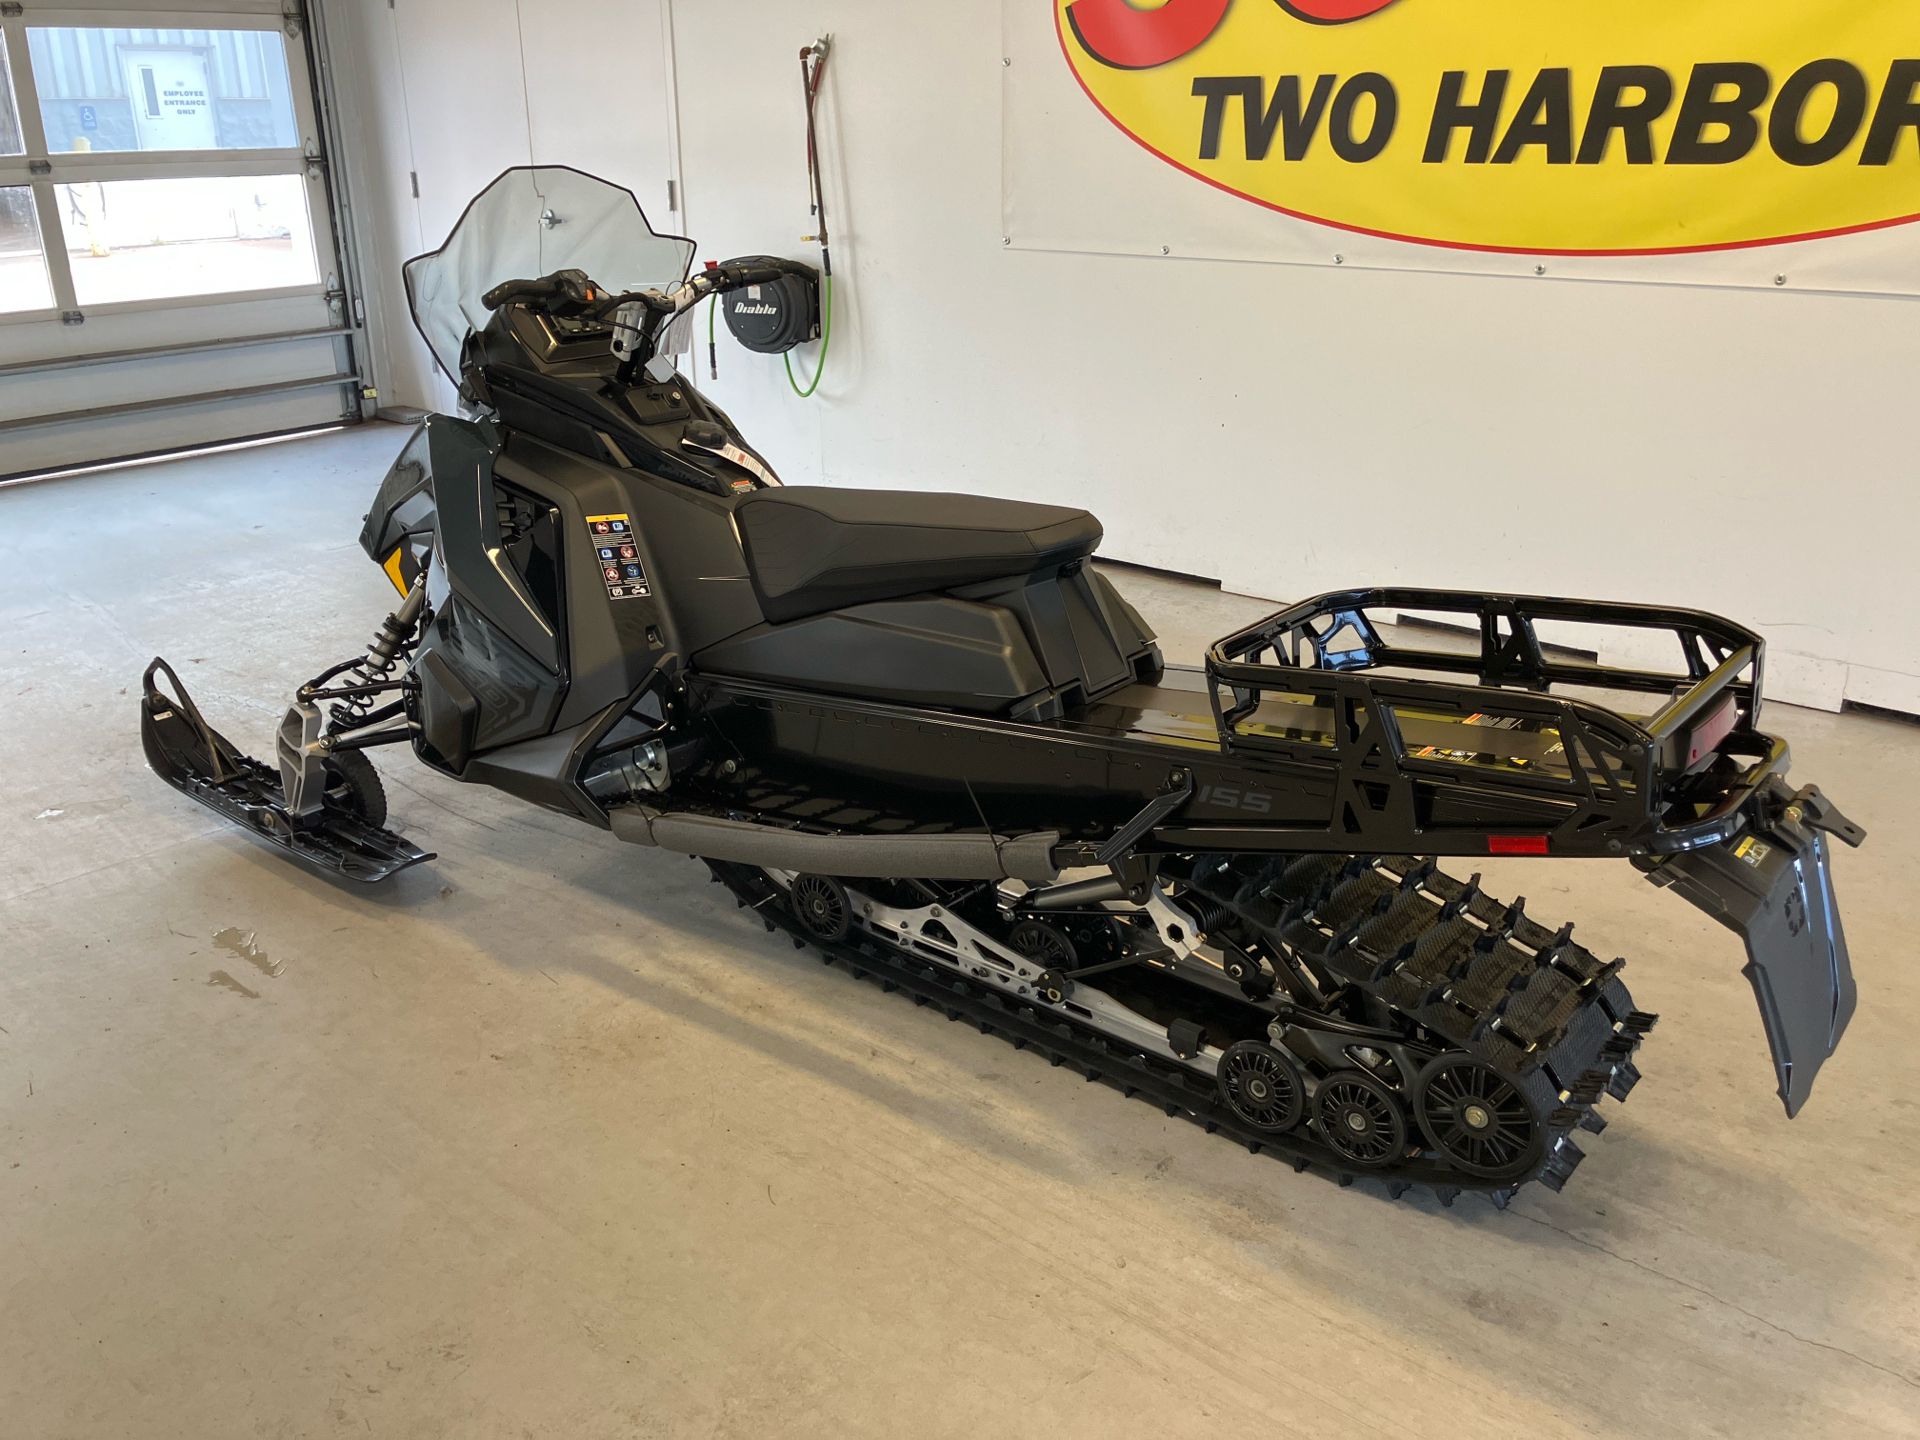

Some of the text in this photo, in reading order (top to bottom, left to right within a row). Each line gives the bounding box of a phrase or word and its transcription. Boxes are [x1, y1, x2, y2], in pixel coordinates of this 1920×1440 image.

[1190, 72, 1397, 163] TWO
[734, 302, 777, 315] Diablo
[1197, 785, 1273, 813] 155
